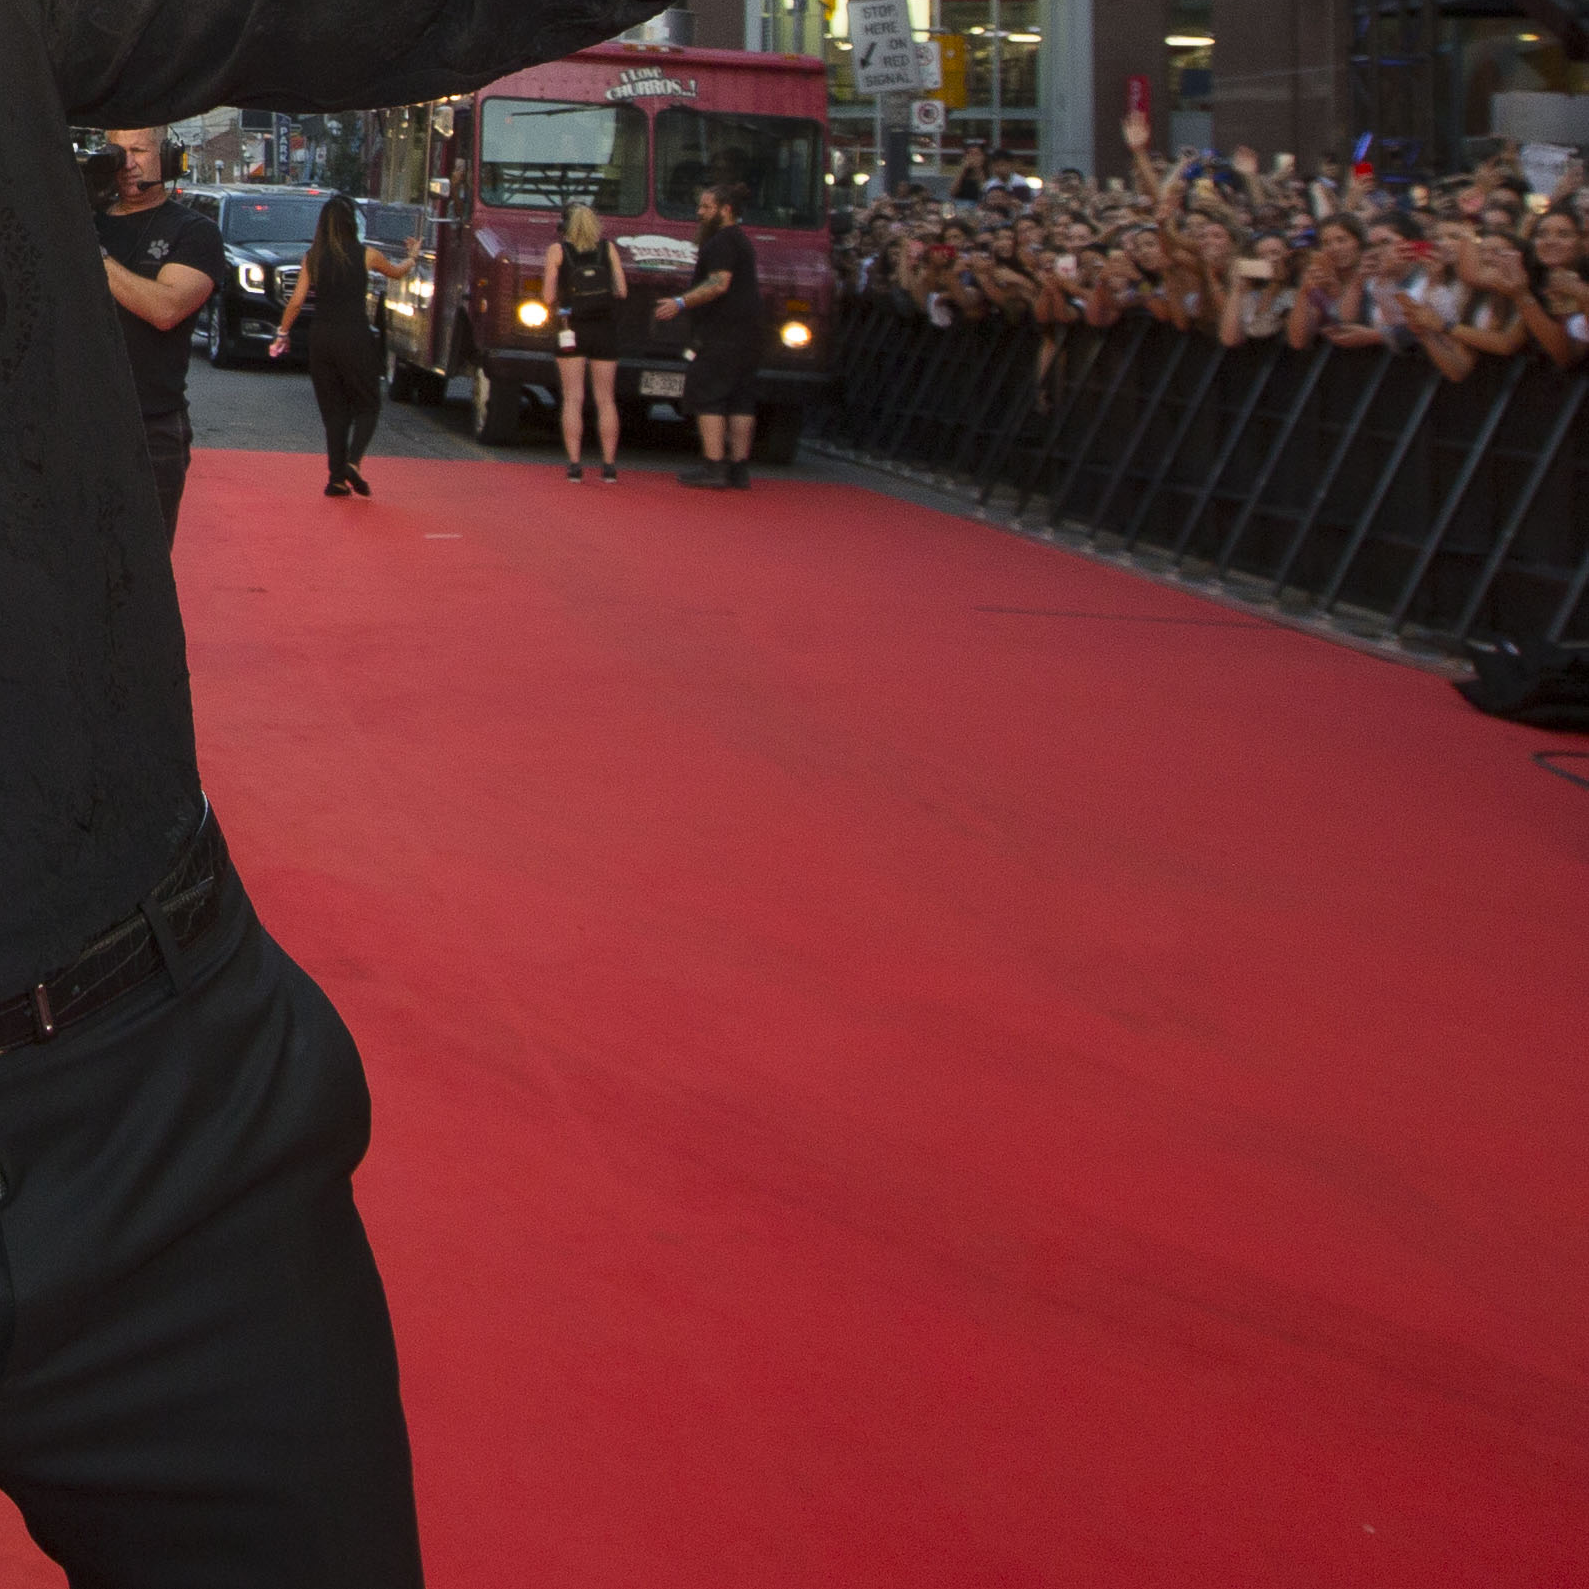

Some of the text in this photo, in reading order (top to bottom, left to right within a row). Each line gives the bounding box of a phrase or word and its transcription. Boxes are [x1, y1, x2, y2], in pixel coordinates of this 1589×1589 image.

[864, 21, 899, 36] HERE
[889, 38, 908, 51] ON
[882, 55, 911, 68] RED
[863, 73, 914, 88] SIGNAL
